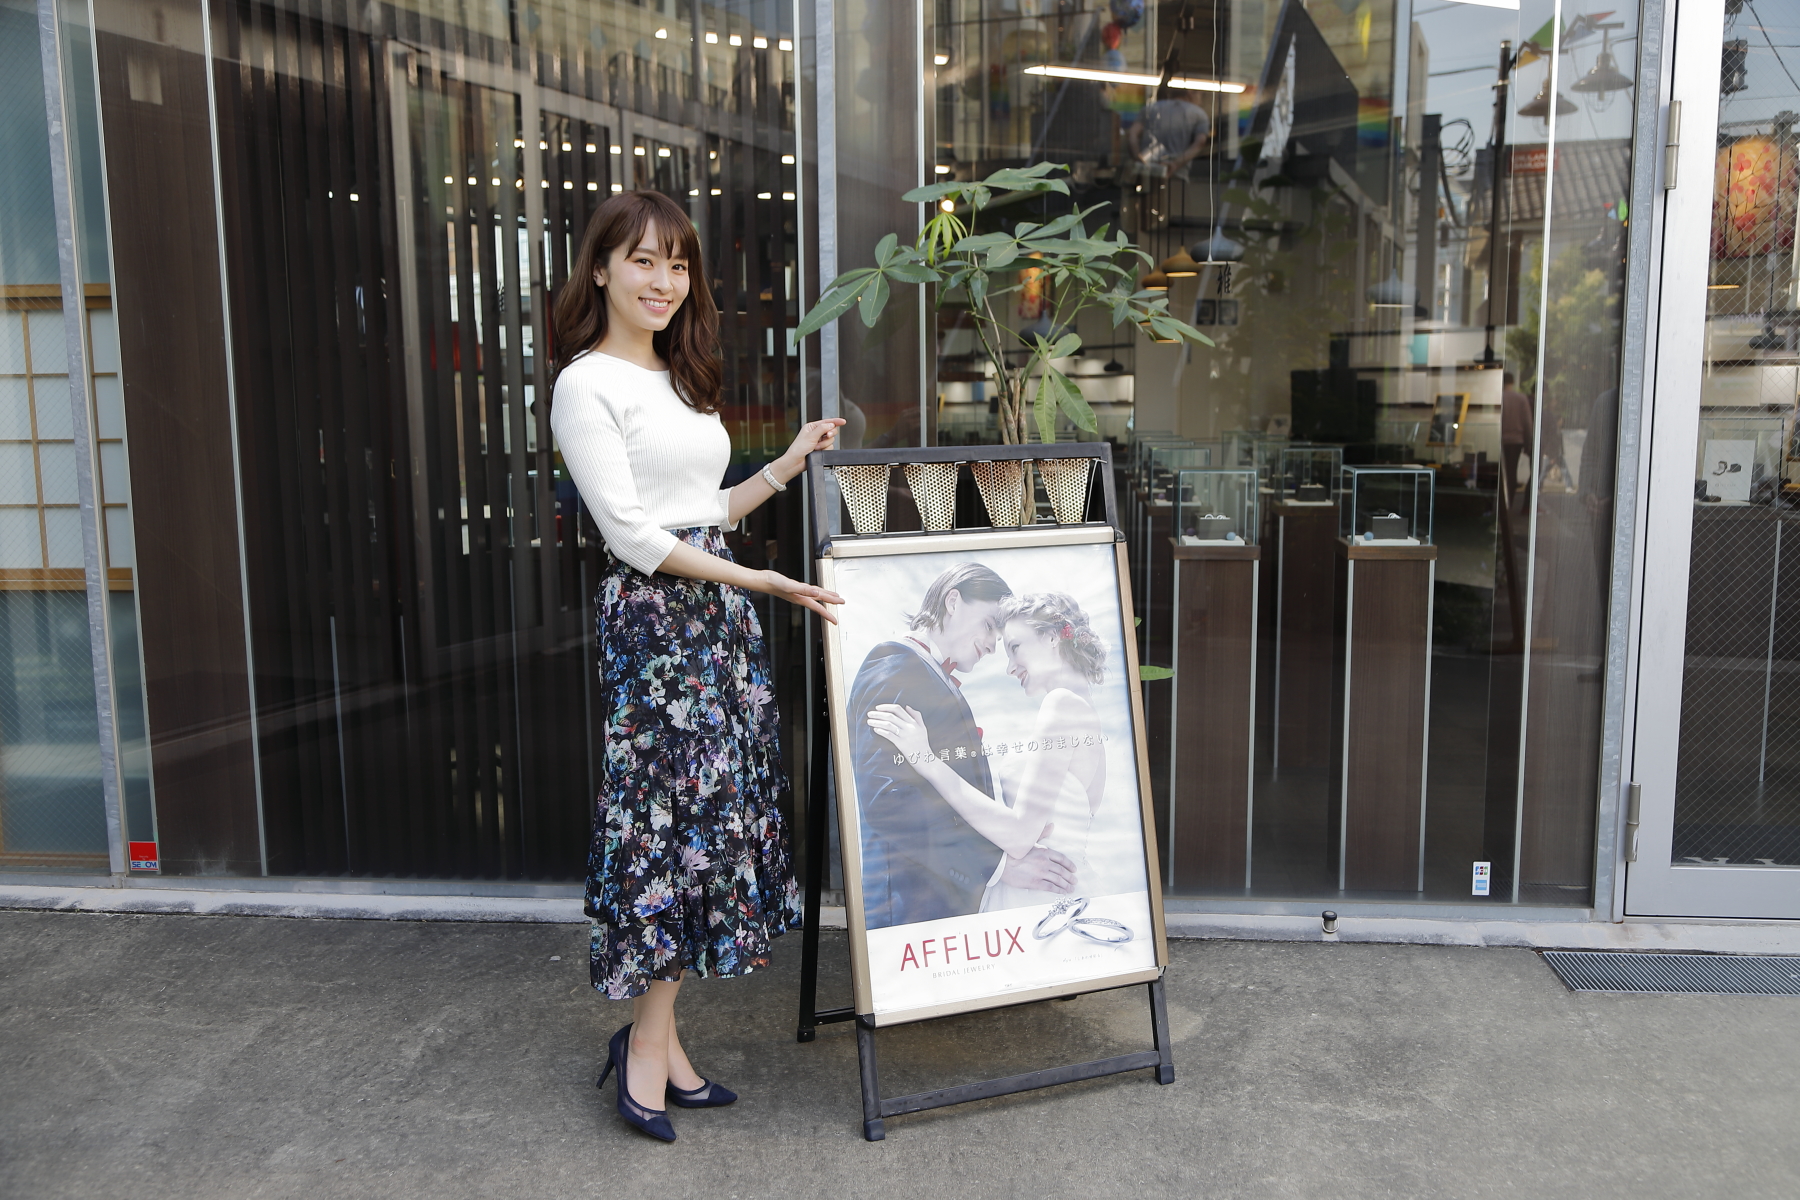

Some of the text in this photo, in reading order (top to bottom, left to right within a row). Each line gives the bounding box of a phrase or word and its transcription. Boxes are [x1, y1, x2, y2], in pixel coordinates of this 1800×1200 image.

[900, 926, 1025, 971] AFFLUX
[932, 963, 996, 979] BRIDAL JEWELRY
